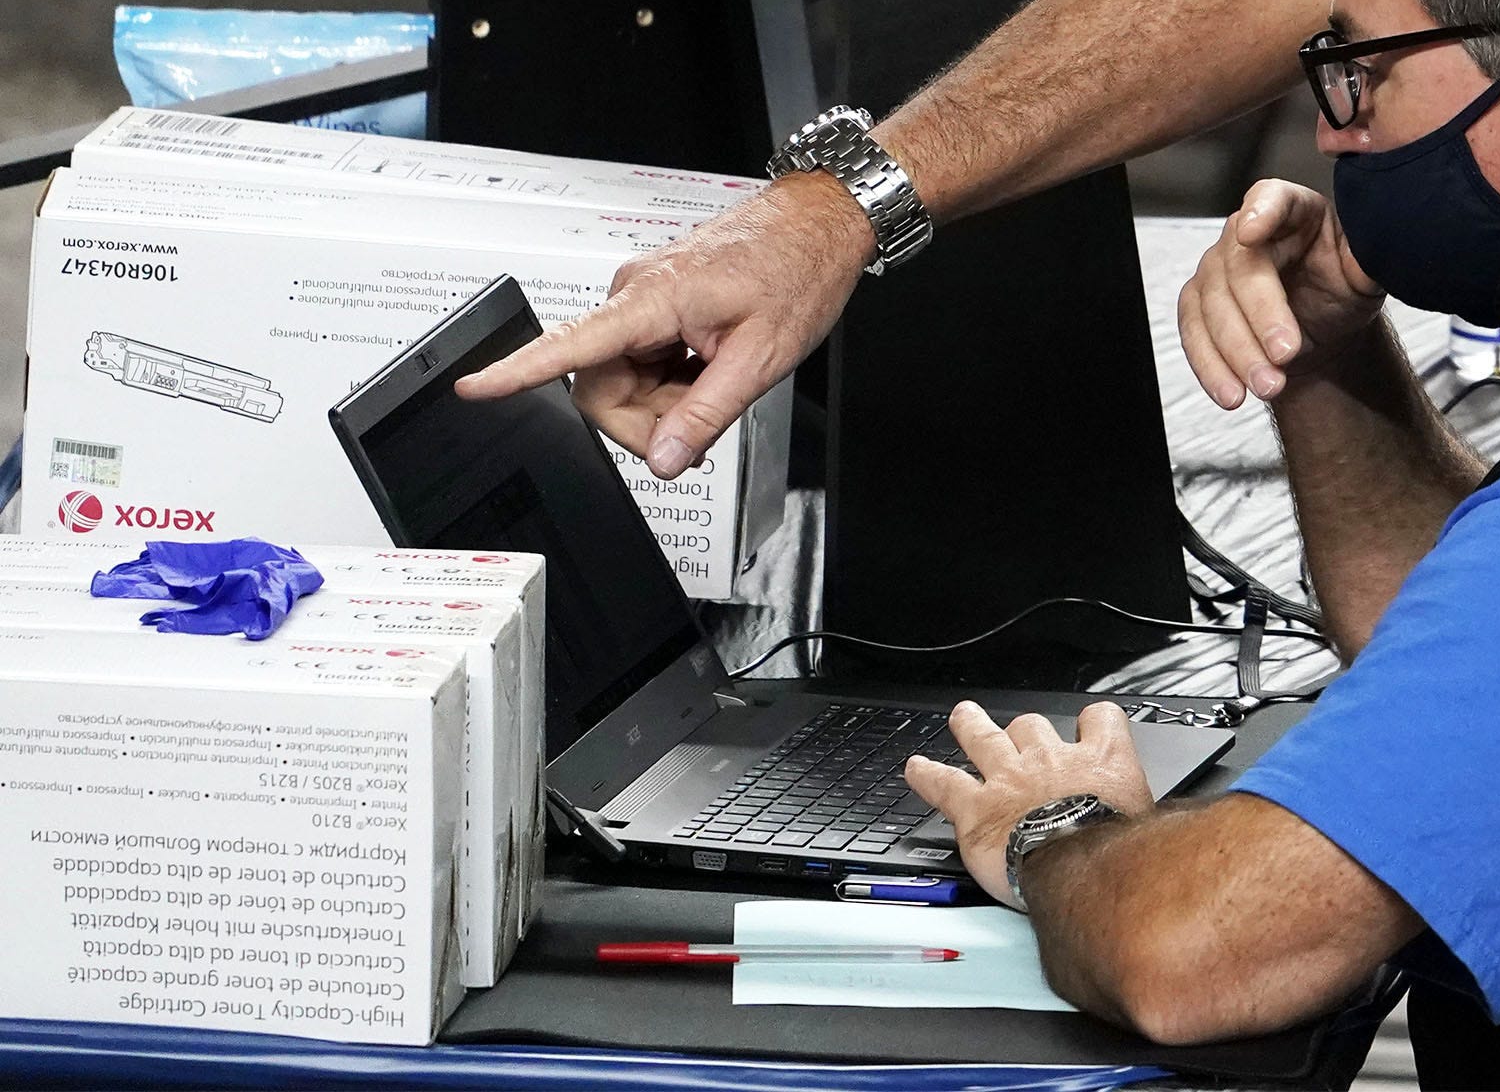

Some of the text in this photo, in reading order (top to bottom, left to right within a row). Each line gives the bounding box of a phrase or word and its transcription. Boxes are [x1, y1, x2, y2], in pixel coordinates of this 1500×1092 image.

[630, 169, 712, 184] xerox
[598, 214, 683, 227] xerox
[62, 237, 178, 255] www.xerox.com
[61, 258, 178, 282] 106R04347
[381, 269, 444, 282] устройство
[301, 279, 383, 294] multifuncional
[385, 284, 447, 300] Impressora
[297, 294, 374, 309] multifunzione
[376, 301, 439, 315] Stampante
[533, 296, 590, 310] Impresora
[269, 327, 318, 342] Принтер
[331, 333, 393, 348] Impressora
[625, 478, 714, 501] Tonerkart
[114, 505, 215, 532] xerox
[638, 506, 712, 528] Cartucc
[654, 533, 710, 553] Carto
[374, 553, 460, 561] xerox
[347, 598, 432, 607] xerox
[288, 644, 376, 654] xerox
[275, 725, 408, 742] Multifunctionele printer
[0, 727, 408, 758] Multifunktionsdrucker Impresora multifunción Impressora multifunci
[0, 743, 408, 773] Multifunction Printer Imprimante multifonction Stampante multifunz
[258, 772, 298, 788] B215
[313, 775, 351, 790] B205
[10, 781, 407, 812] Printer Imprimante Stampante Drucker Impresora Impressora
[312, 813, 351, 829] B210
[30, 830, 109, 846] емкости
[115, 834, 201, 855] большой
[207, 837, 289, 856] тонером
[309, 842, 406, 866] Картридж
[53, 858, 406, 893] Cartucho de toner de alta capacidade
[64, 885, 406, 920] Cartucho de tóner de alta capacidad
[71, 912, 406, 946] Tonerkartusche mit hoher Kapazität
[83, 939, 405, 973] Cartuccia di toner ad alta capacità
[67, 966, 405, 1000] Cartouche de toner grande capacité
[119, 992, 405, 1027] High-Capacity Toner Cartridge
